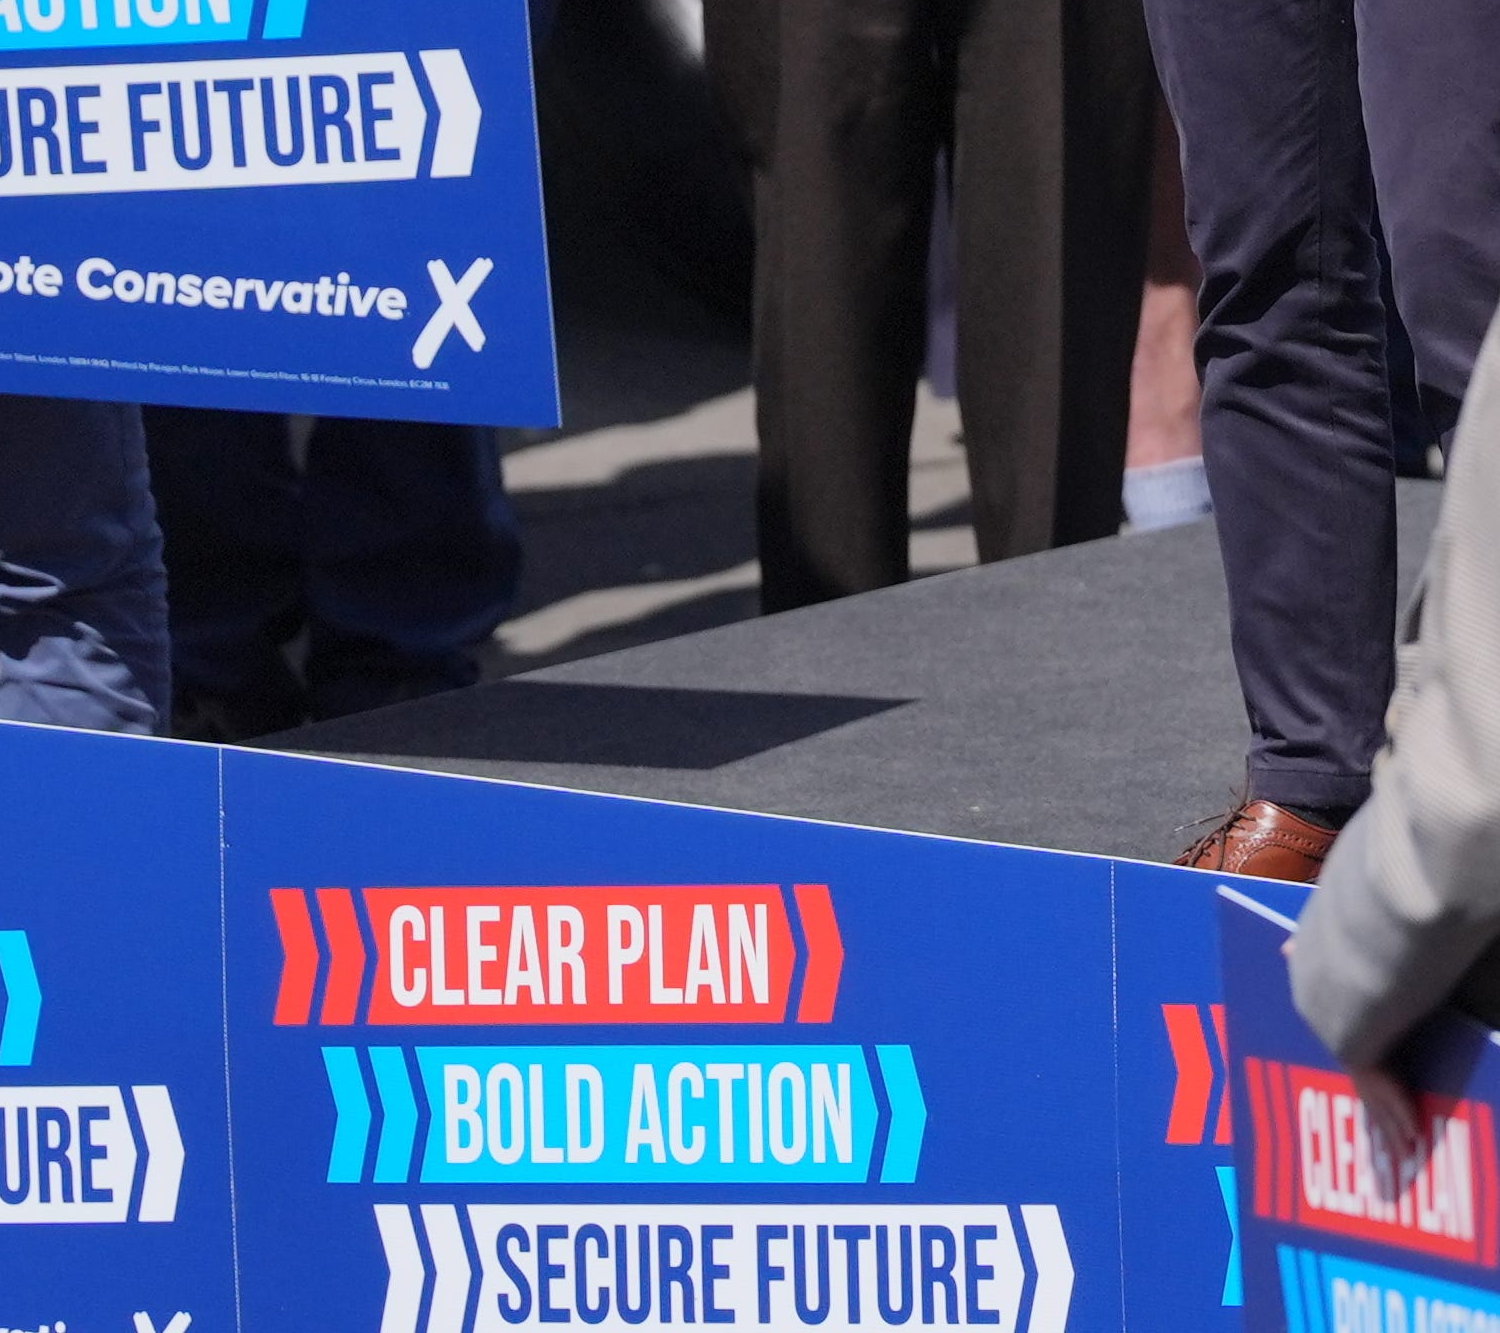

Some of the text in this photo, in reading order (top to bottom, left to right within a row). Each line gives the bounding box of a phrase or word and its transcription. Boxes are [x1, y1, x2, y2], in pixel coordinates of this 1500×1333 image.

[126, 70, 400, 173] FUTURE
[75, 256, 407, 321] Conservative
[389, 904, 770, 1007] CLEAR PLAN
[443, 1062, 853, 1164] BOLD ACTION
[1299, 1087, 1475, 1242] CLEA LAN
[496, 1224, 999, 1325] SECURE FUTURE
